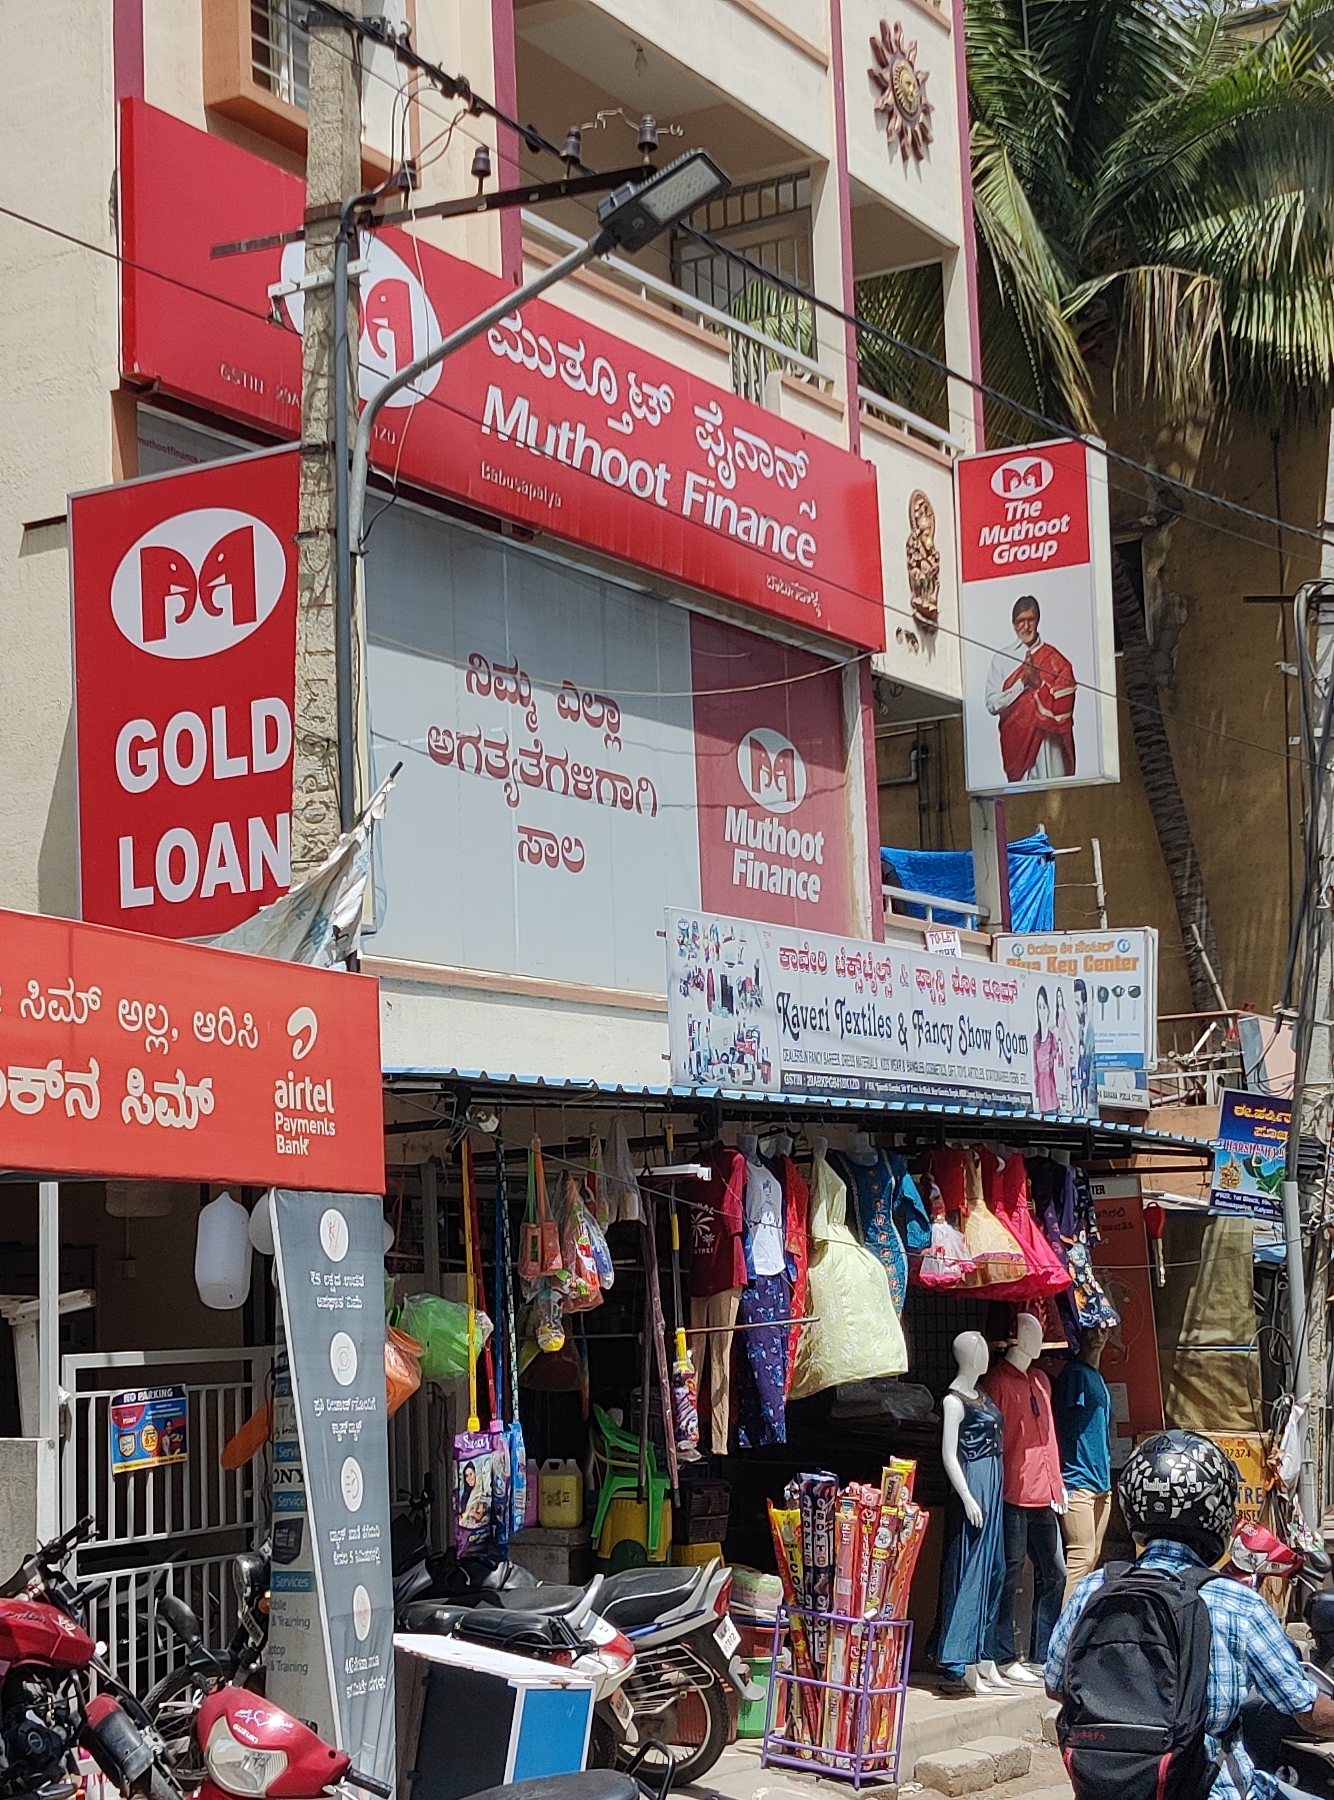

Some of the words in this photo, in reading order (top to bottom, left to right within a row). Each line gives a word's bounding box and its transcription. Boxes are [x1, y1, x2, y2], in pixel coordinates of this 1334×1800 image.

[480, 384, 673, 508] Muthoot
[680, 471, 818, 571] Finance
[978, 513, 1071, 547] Muthoot
[1004, 499, 1043, 522] The
[993, 539, 1058, 566] Group
[465, 651, 540, 735] ನಿಮ್ಮ
[115, 695, 293, 795] GOLD
[117, 812, 291, 911] LOAN
[517, 822, 587, 876] ಸಾಲ
[724, 805, 825, 866] Muthoot
[732, 847, 822, 907] Finance
[1083, 955, 1140, 973] Center
[19, 977, 103, 1027] ಸಿಮ್
[776, 992, 831, 1042] Kaveri
[834, 998, 893, 1041] Textiles
[897, 1014, 909, 1052] &
[911, 1011, 954, 1056] Fancy
[958, 1015, 992, 1055] Show
[995, 1019, 1029, 1065] Room
[120, 1067, 215, 1131] ಸಿಮ್
[274, 1070, 335, 1114] airtel
[274, 1113, 337, 1140] Payments
[275, 1133, 311, 1159] Bank
[137, 1387, 174, 1402] PARKING
